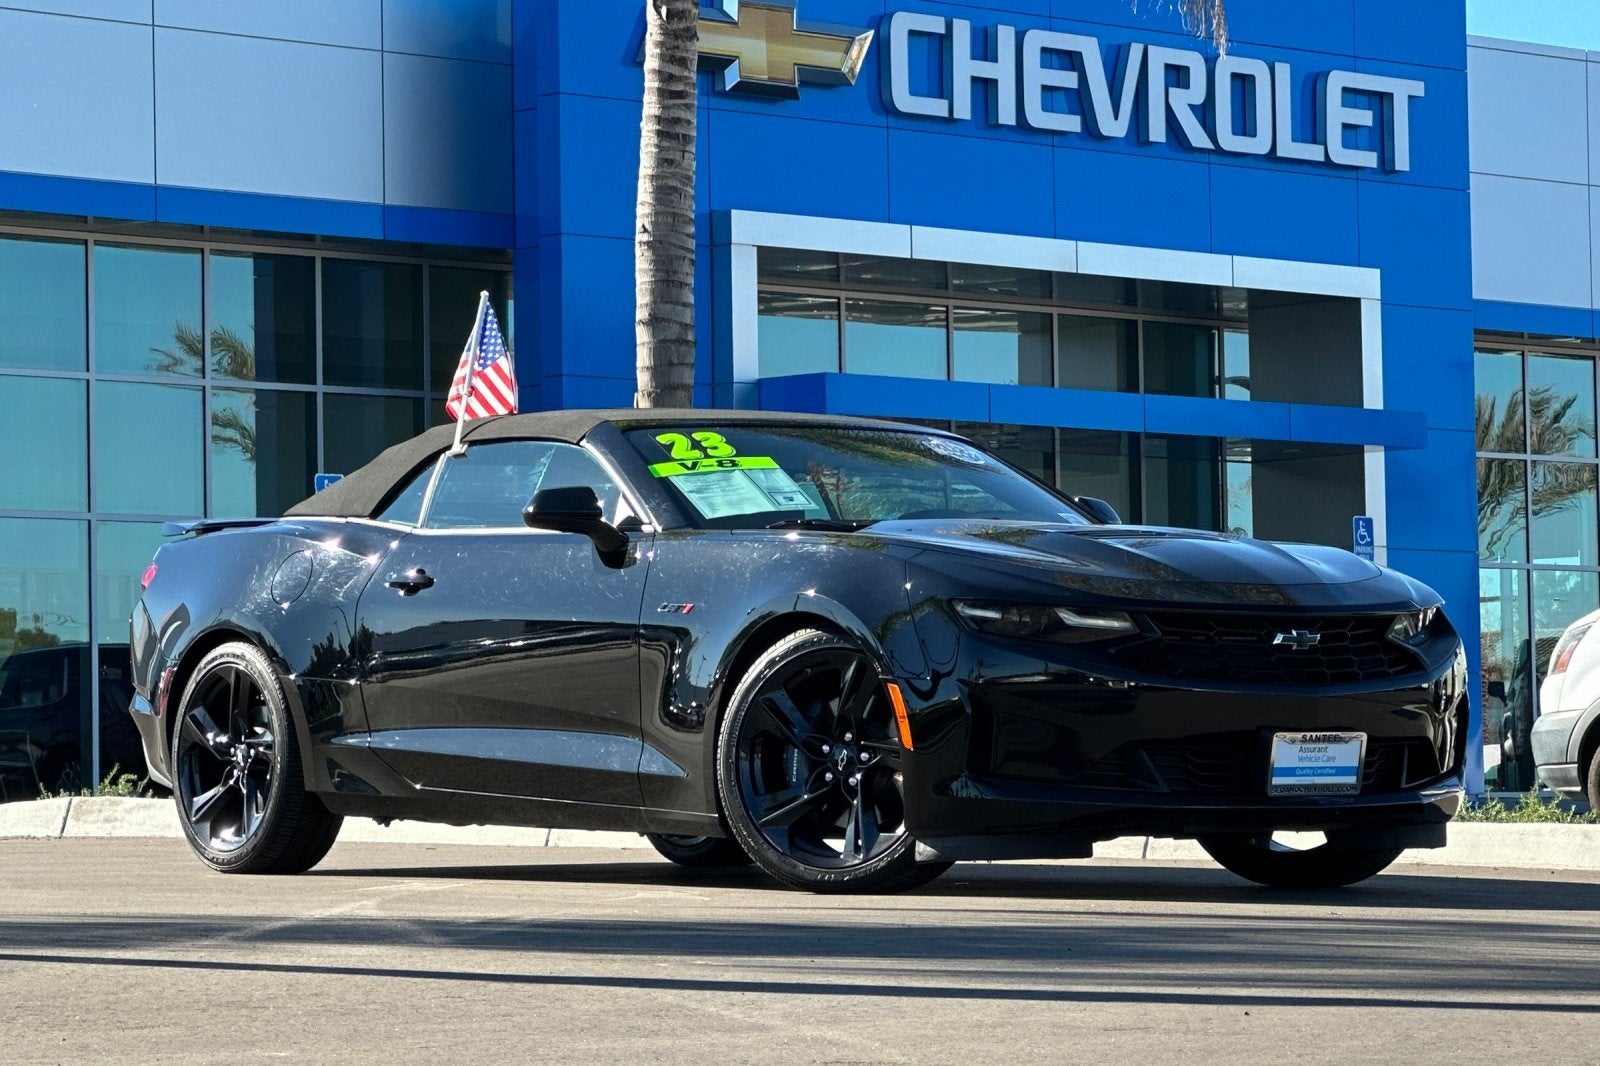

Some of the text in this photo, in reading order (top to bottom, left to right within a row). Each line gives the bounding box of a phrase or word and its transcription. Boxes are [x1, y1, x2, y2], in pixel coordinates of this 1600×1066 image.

[888, 11, 1425, 172] CHEVROLET
[655, 431, 736, 460] 23
[677, 458, 741, 471] V-8
[1301, 733, 1341, 743] SANTEE
[1298, 745, 1329, 754] Assurant
[1298, 753, 1337, 763] Vehicle Care
[1295, 767, 1336, 776] Quality Certified
